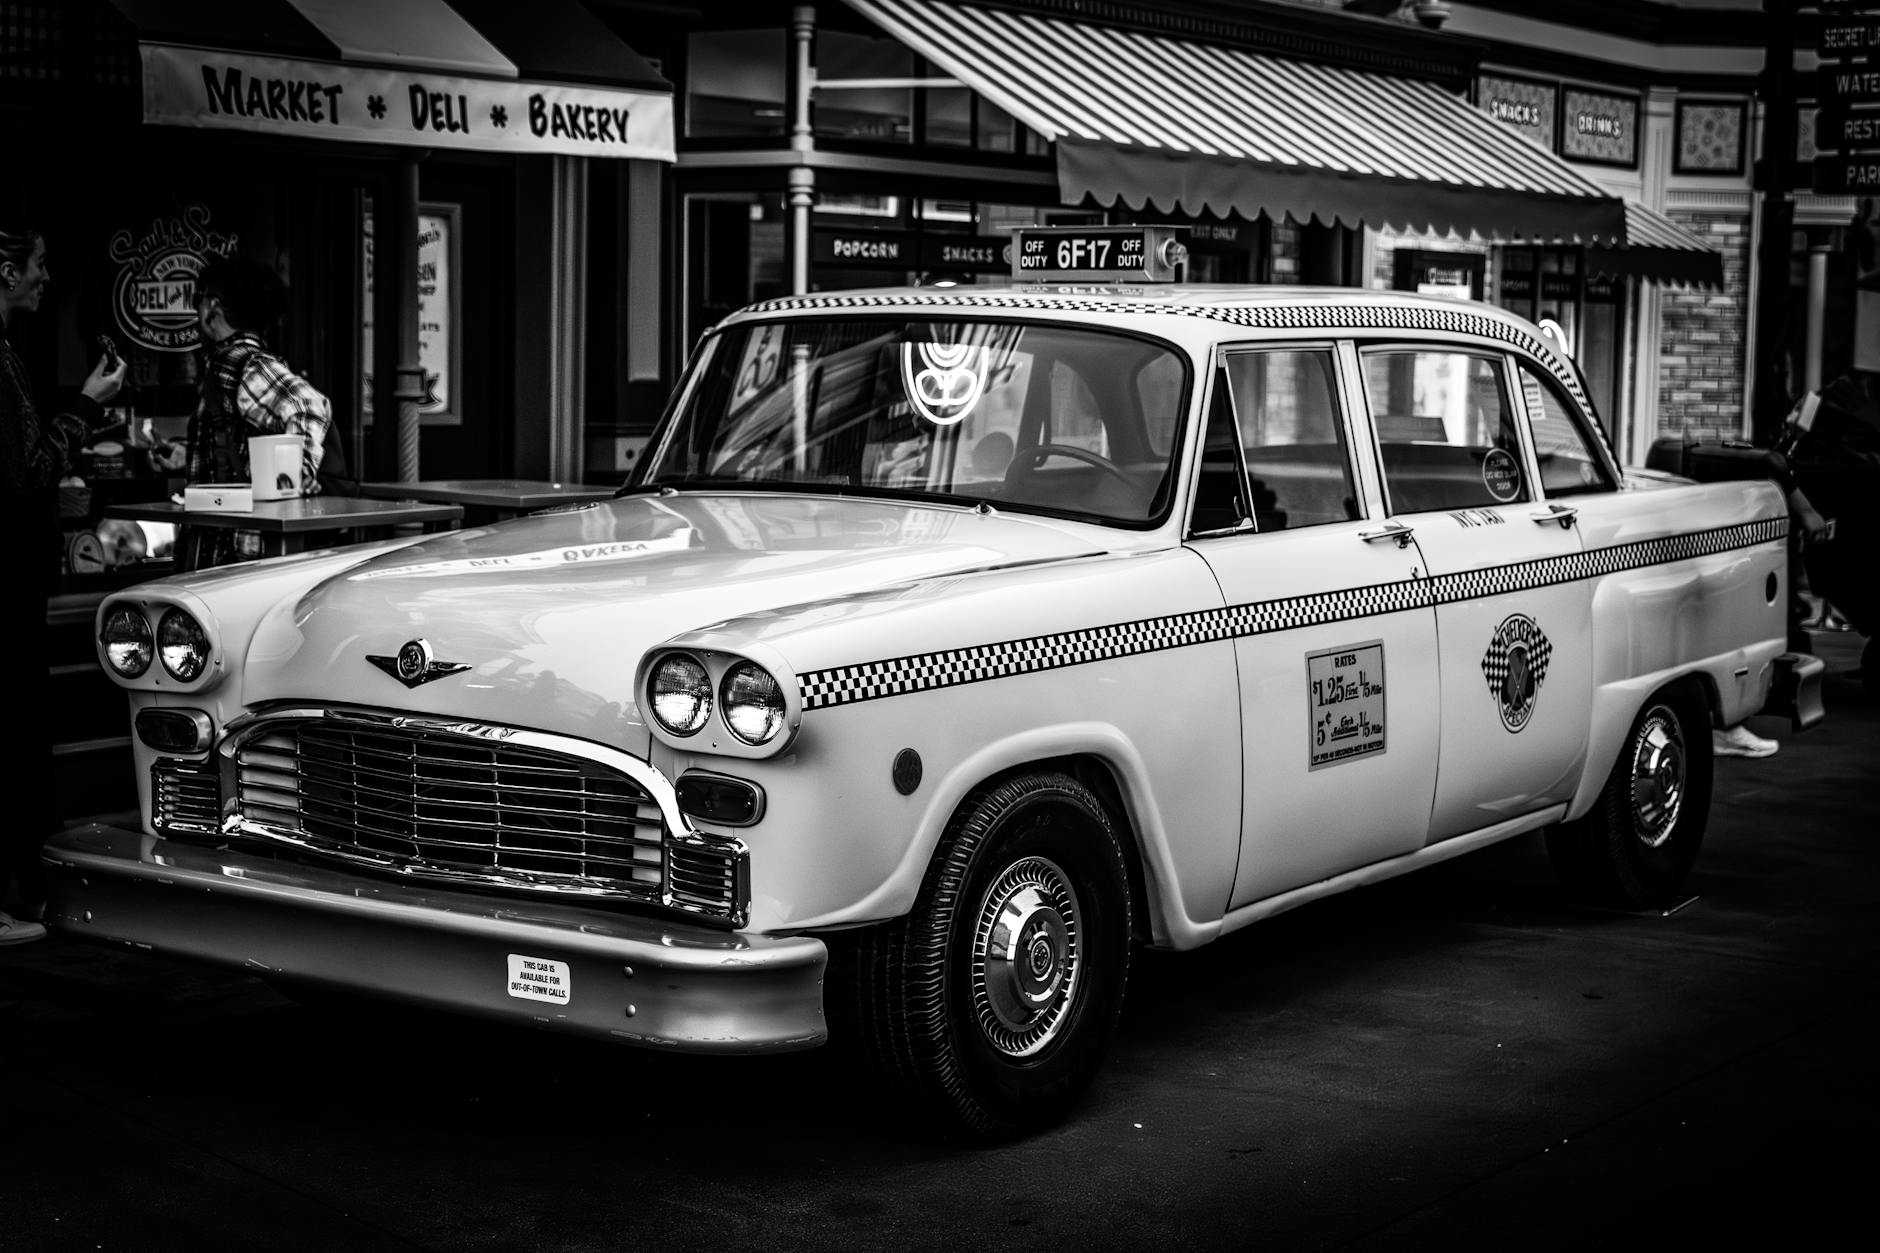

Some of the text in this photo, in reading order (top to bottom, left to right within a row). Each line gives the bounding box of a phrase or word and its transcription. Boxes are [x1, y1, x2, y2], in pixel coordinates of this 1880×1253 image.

[1824, 26, 1866, 48] SECRET
[202, 65, 629, 144] MARKET DELI BAKERY
[1489, 98, 1541, 126] SNACKS
[1577, 113, 1623, 139] DRINKS
[1844, 118, 1880, 140] REST
[1846, 164, 1880, 187] PAR
[833, 238, 900, 259] POPCORN
[942, 246, 994, 263] SNACKS
[1025, 240, 1045, 252] OFF
[1056, 238, 1112, 269] 6F17
[1121, 239, 1142, 251] OFF
[1021, 255, 1048, 268] DUTY
[1117, 254, 1145, 267] DUTY
[139, 285, 168, 310] DELI
[139, 325, 172, 346] SINCE
[1334, 654, 1356, 668] RATES
[523, 961, 555, 973] THIS CAB IS
[520, 971, 560, 985] AVAILABLE FOR
[511, 981, 567, 998] OUT-OF-TOWN CALLS.
